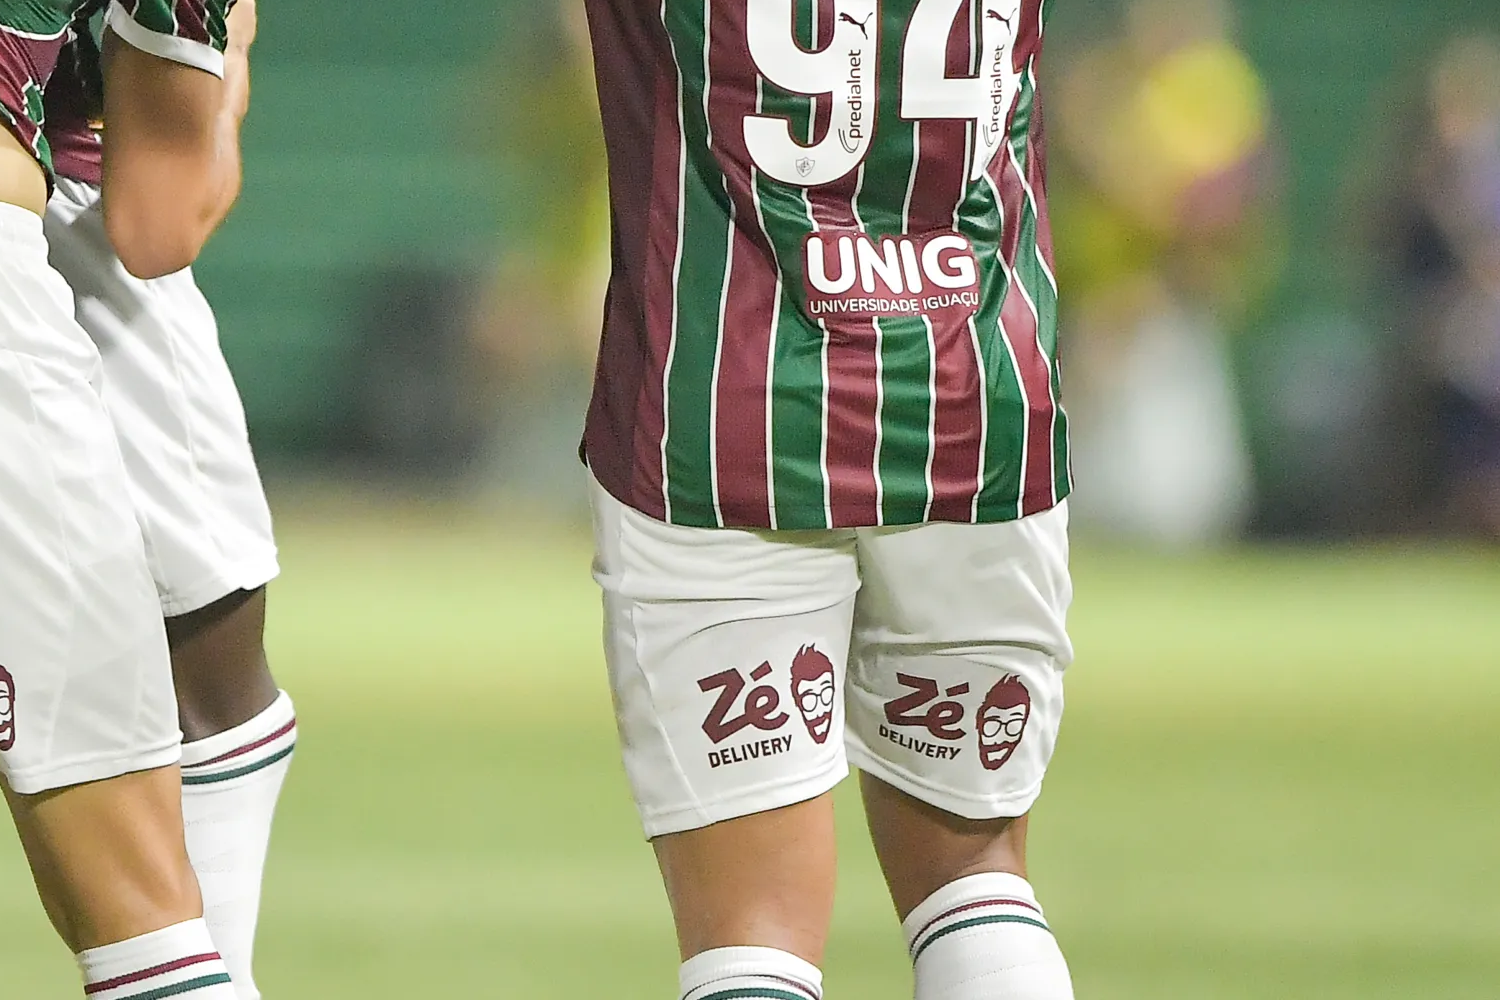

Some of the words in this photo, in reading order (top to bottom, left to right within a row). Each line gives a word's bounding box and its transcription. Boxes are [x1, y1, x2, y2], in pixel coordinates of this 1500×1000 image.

[846, 48, 864, 139] predialnet
[990, 43, 1005, 133] predialnet
[806, 235, 977, 294] UNIG
[810, 298, 919, 314] UNIVERSIDADE
[922, 292, 979, 311] IGUAÇU
[697, 660, 790, 744] Zé
[883, 671, 970, 740] Zé
[708, 734, 793, 769] DELIVERY
[879, 724, 961, 760] DELIVERY
